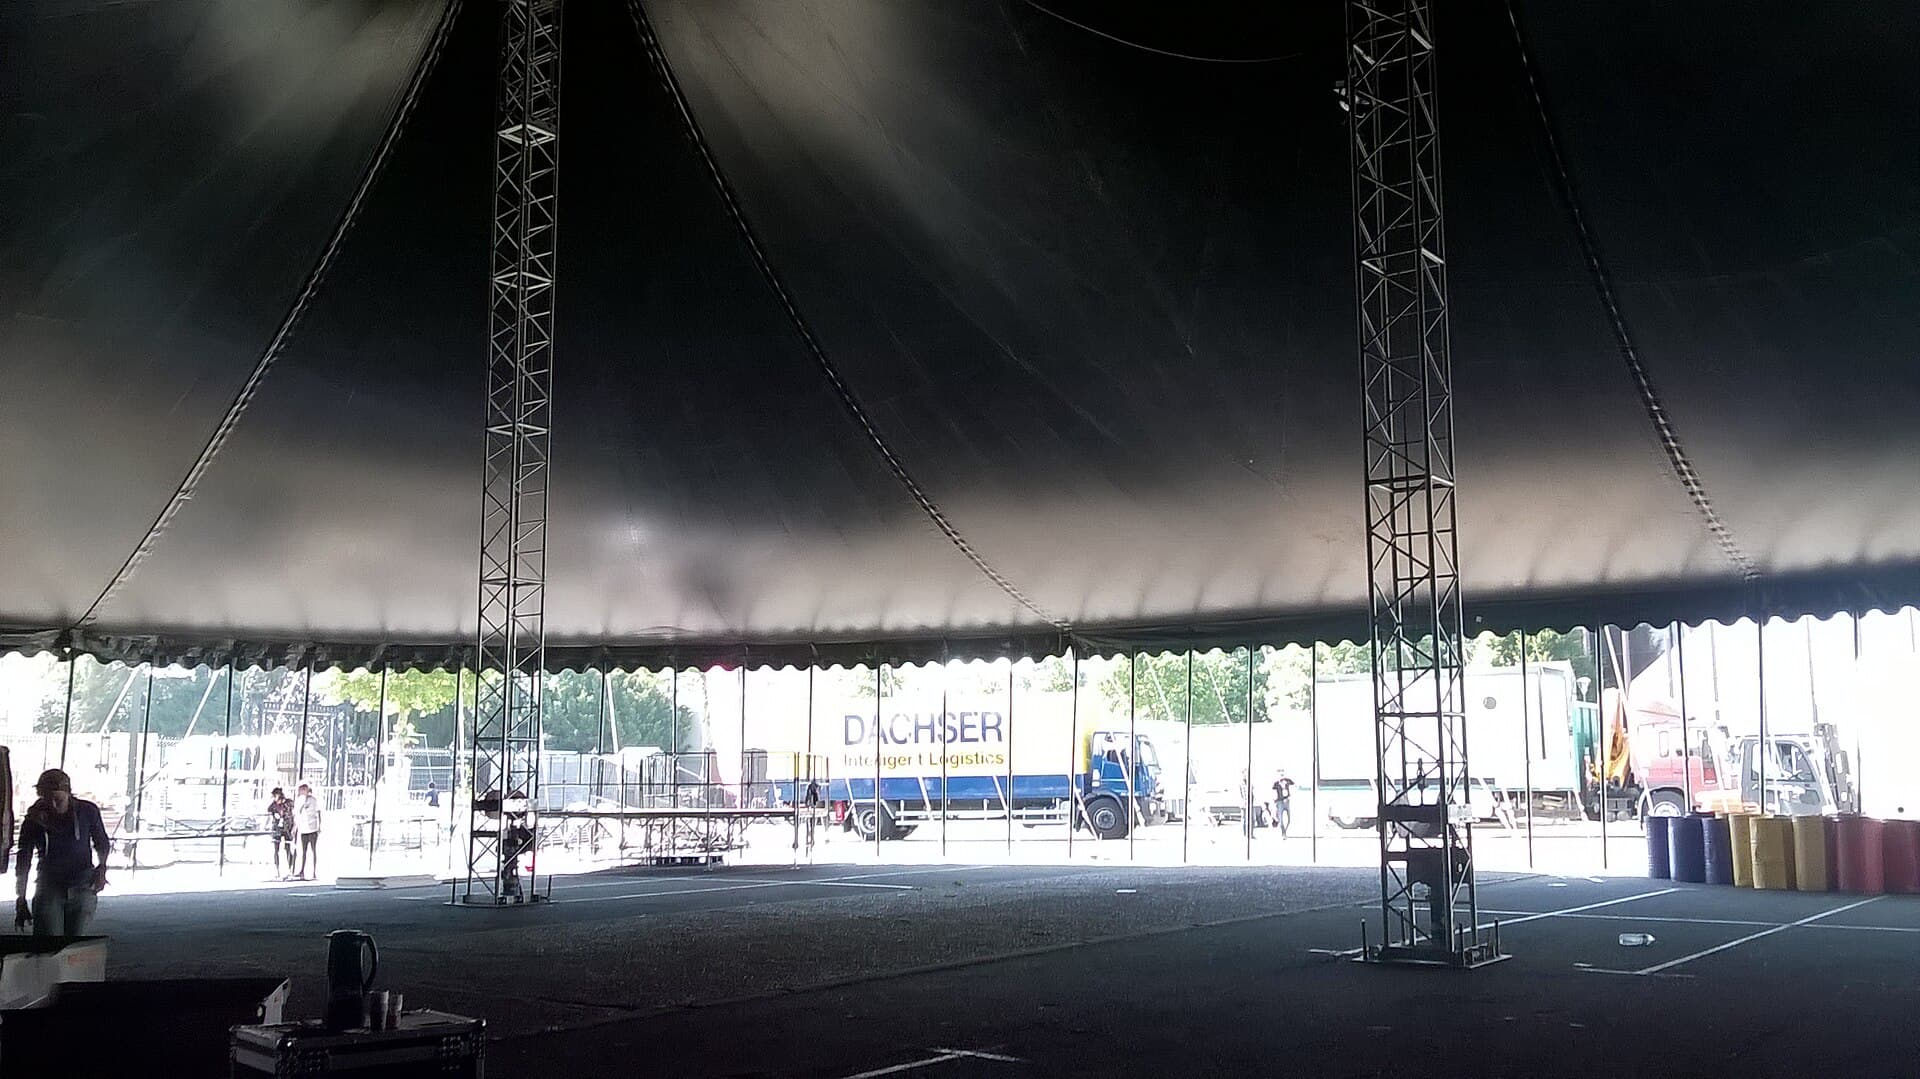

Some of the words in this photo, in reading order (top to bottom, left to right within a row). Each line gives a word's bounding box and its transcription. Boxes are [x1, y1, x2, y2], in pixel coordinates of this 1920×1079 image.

[844, 711, 1003, 746] DACHSER
[844, 752, 923, 769] Inteiget
[929, 751, 1004, 769] Logistics
